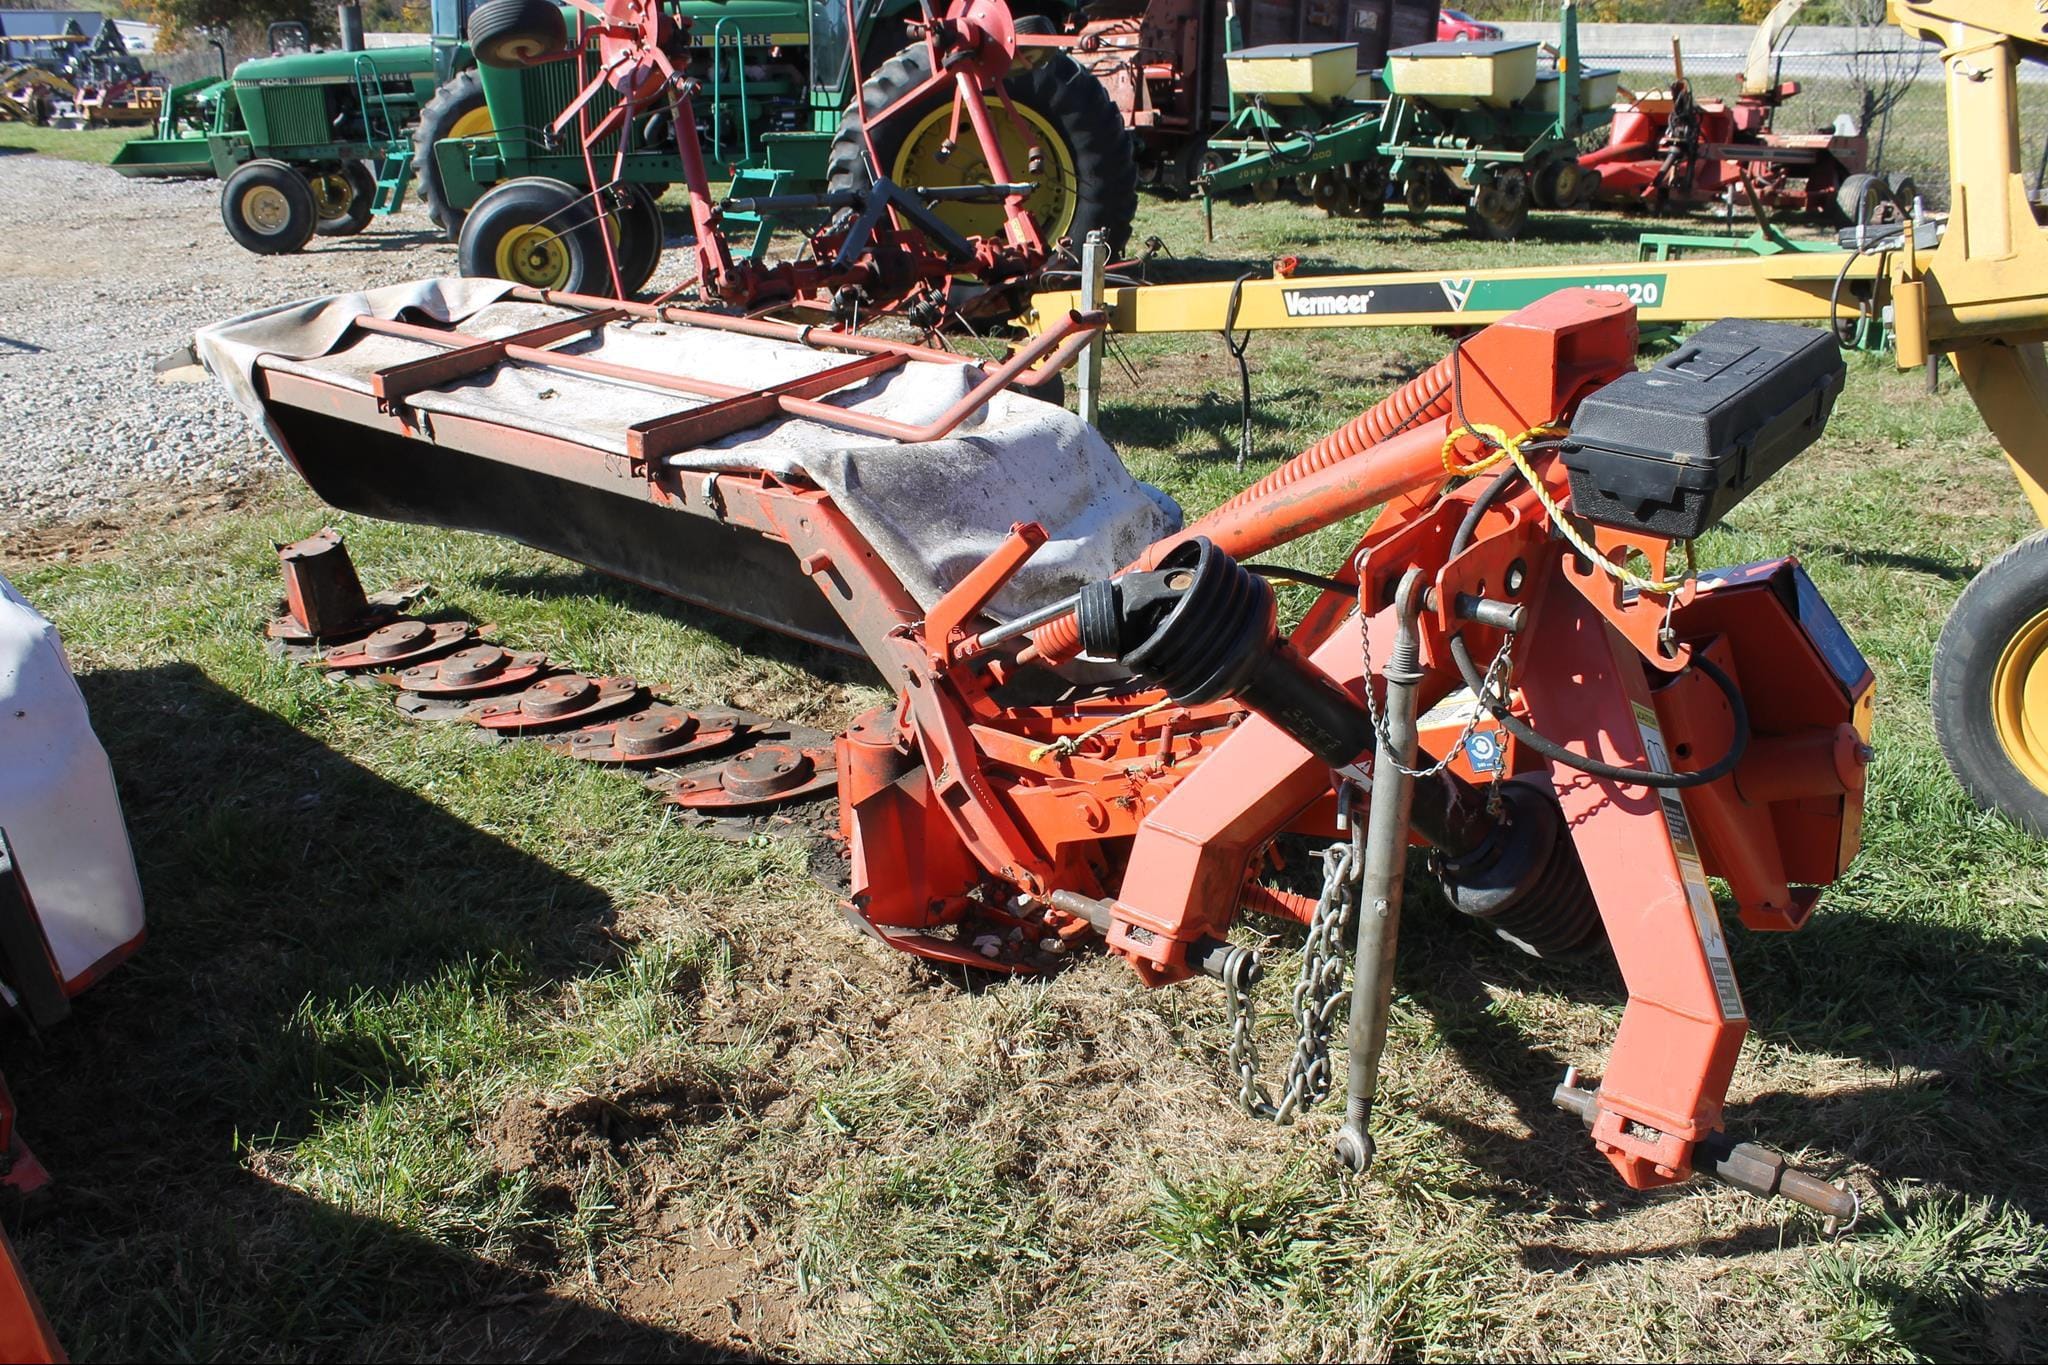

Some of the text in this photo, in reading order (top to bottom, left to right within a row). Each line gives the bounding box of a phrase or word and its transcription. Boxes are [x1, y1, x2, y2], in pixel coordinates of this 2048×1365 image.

[719, 34, 772, 47] DEERE
[259, 77, 289, 87] 4040
[1284, 290, 1370, 316] Vermeer
